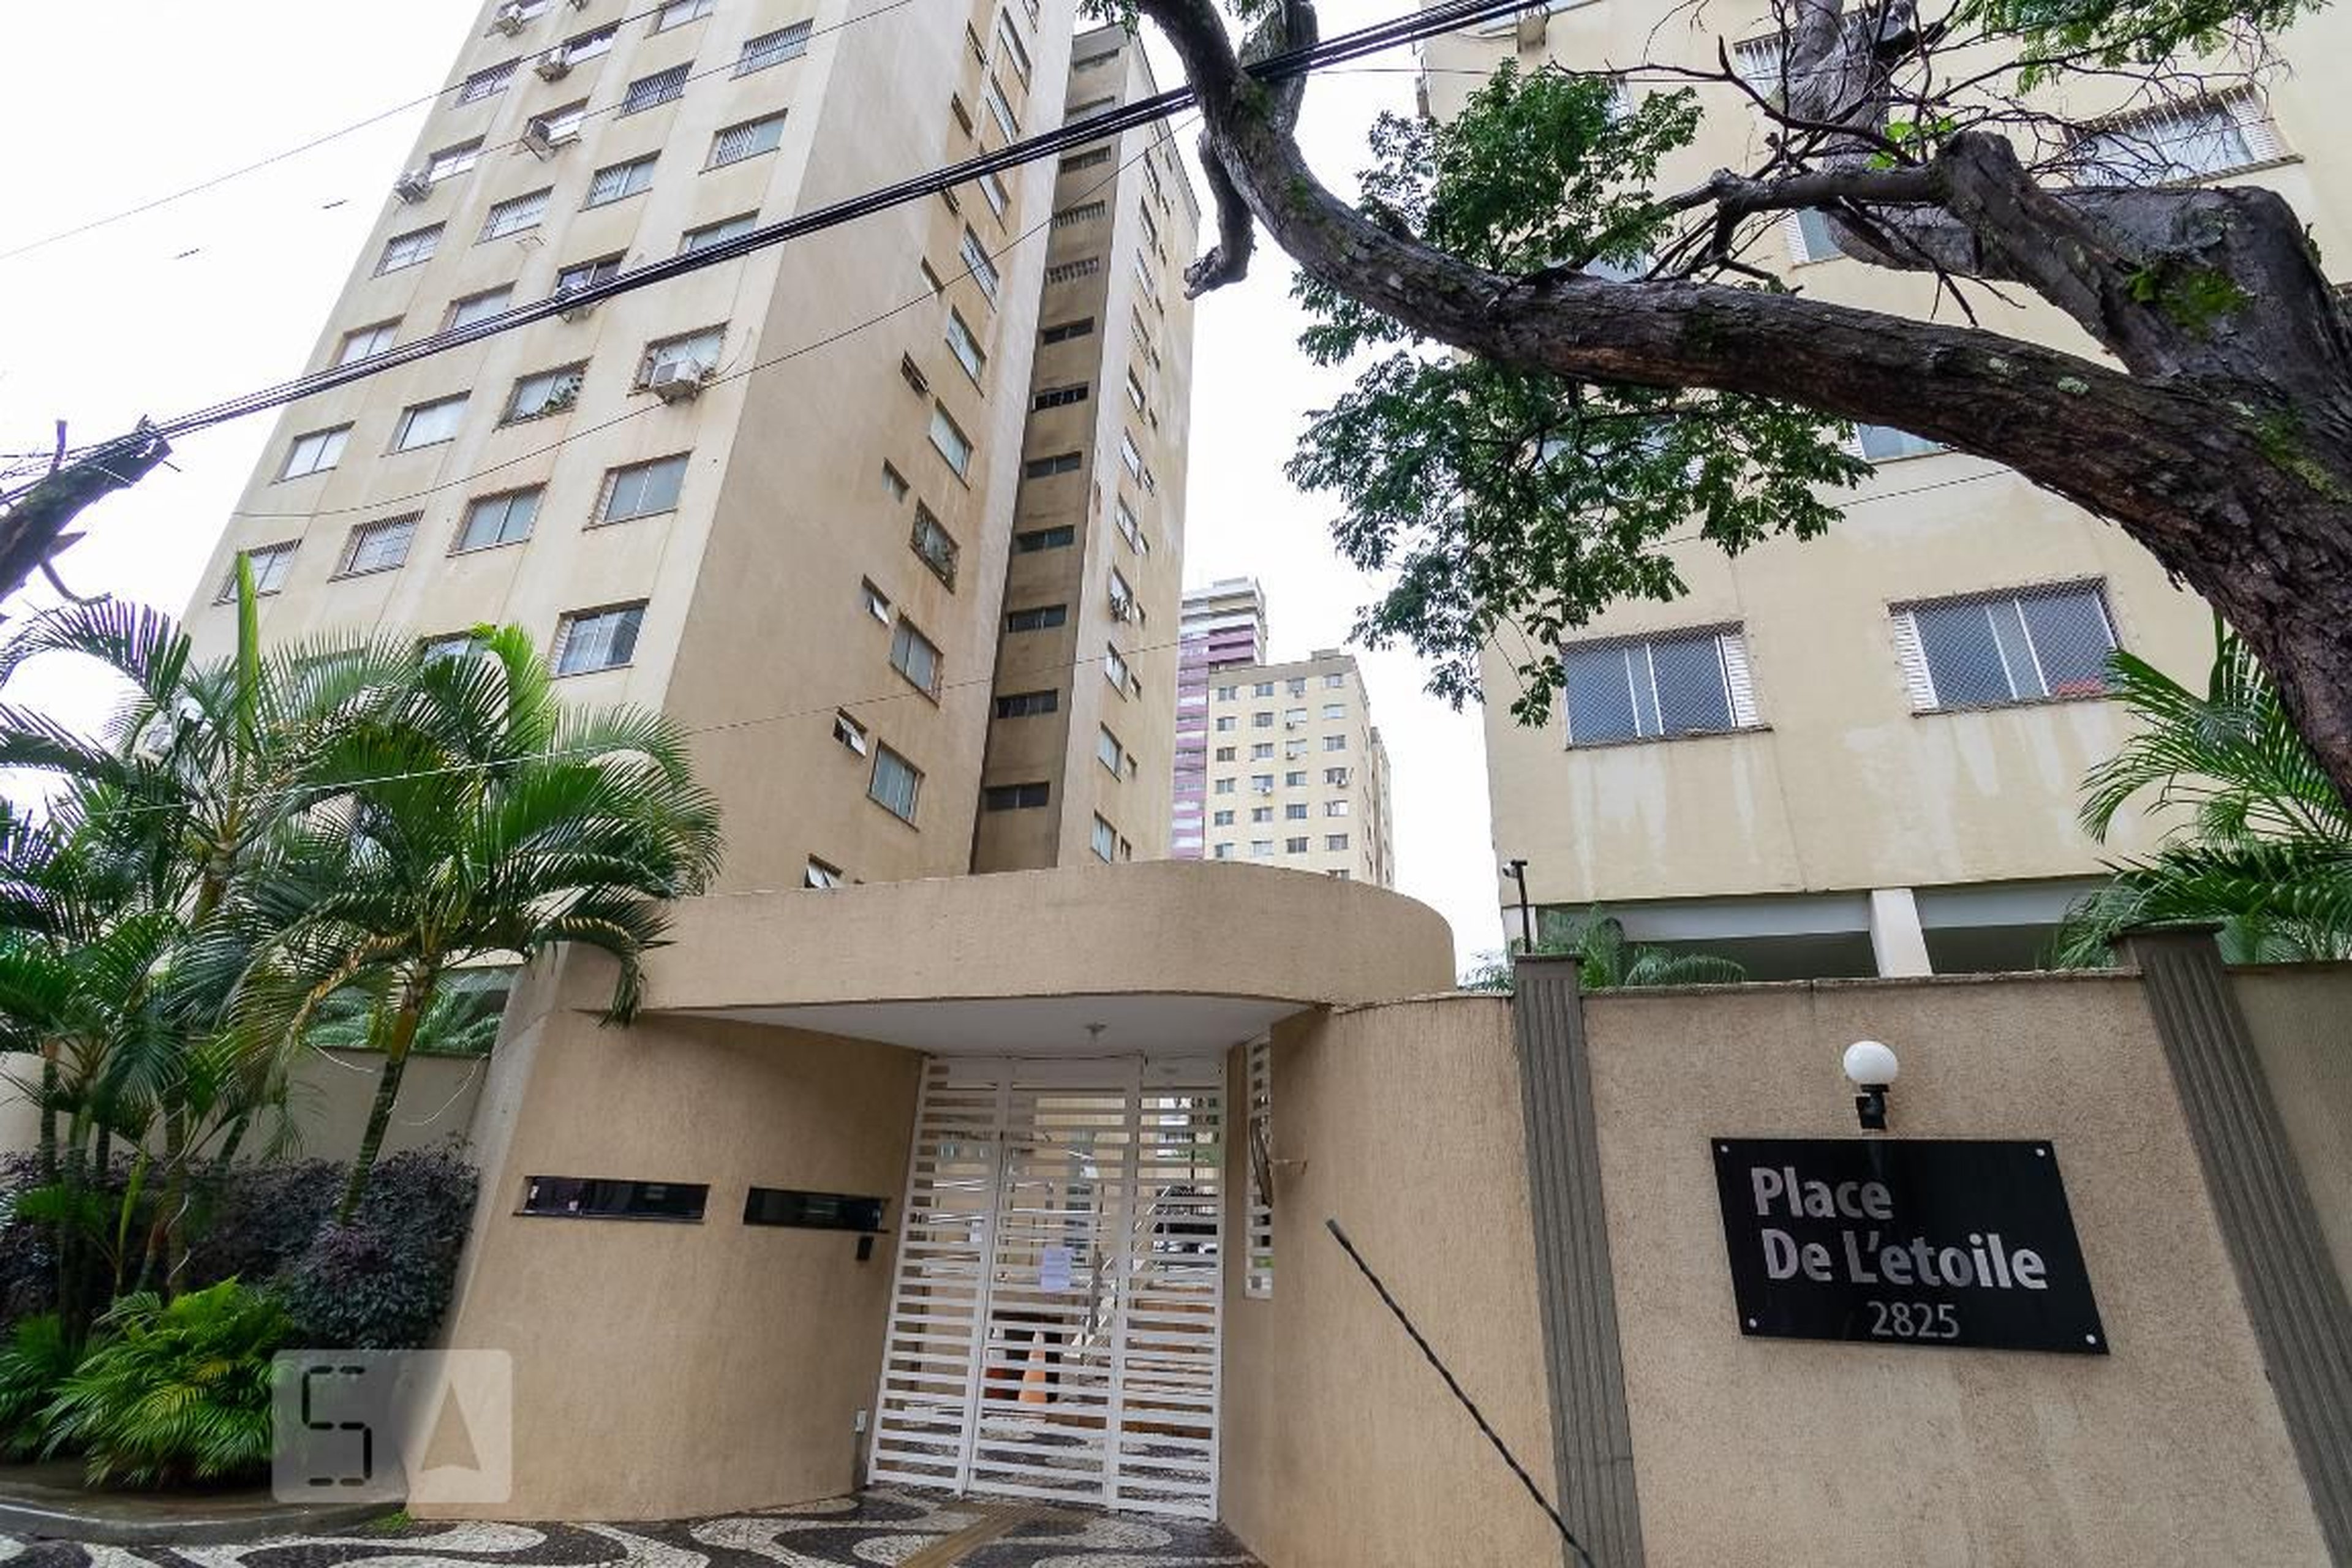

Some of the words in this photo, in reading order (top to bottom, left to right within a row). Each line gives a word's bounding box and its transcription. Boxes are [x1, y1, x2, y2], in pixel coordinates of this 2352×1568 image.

[1751, 1166, 1893, 1219] Place
[1761, 1228, 1833, 1282] De
[1843, 1230, 2048, 1289] L'etoile
[1867, 1302, 1960, 1338] 2825
